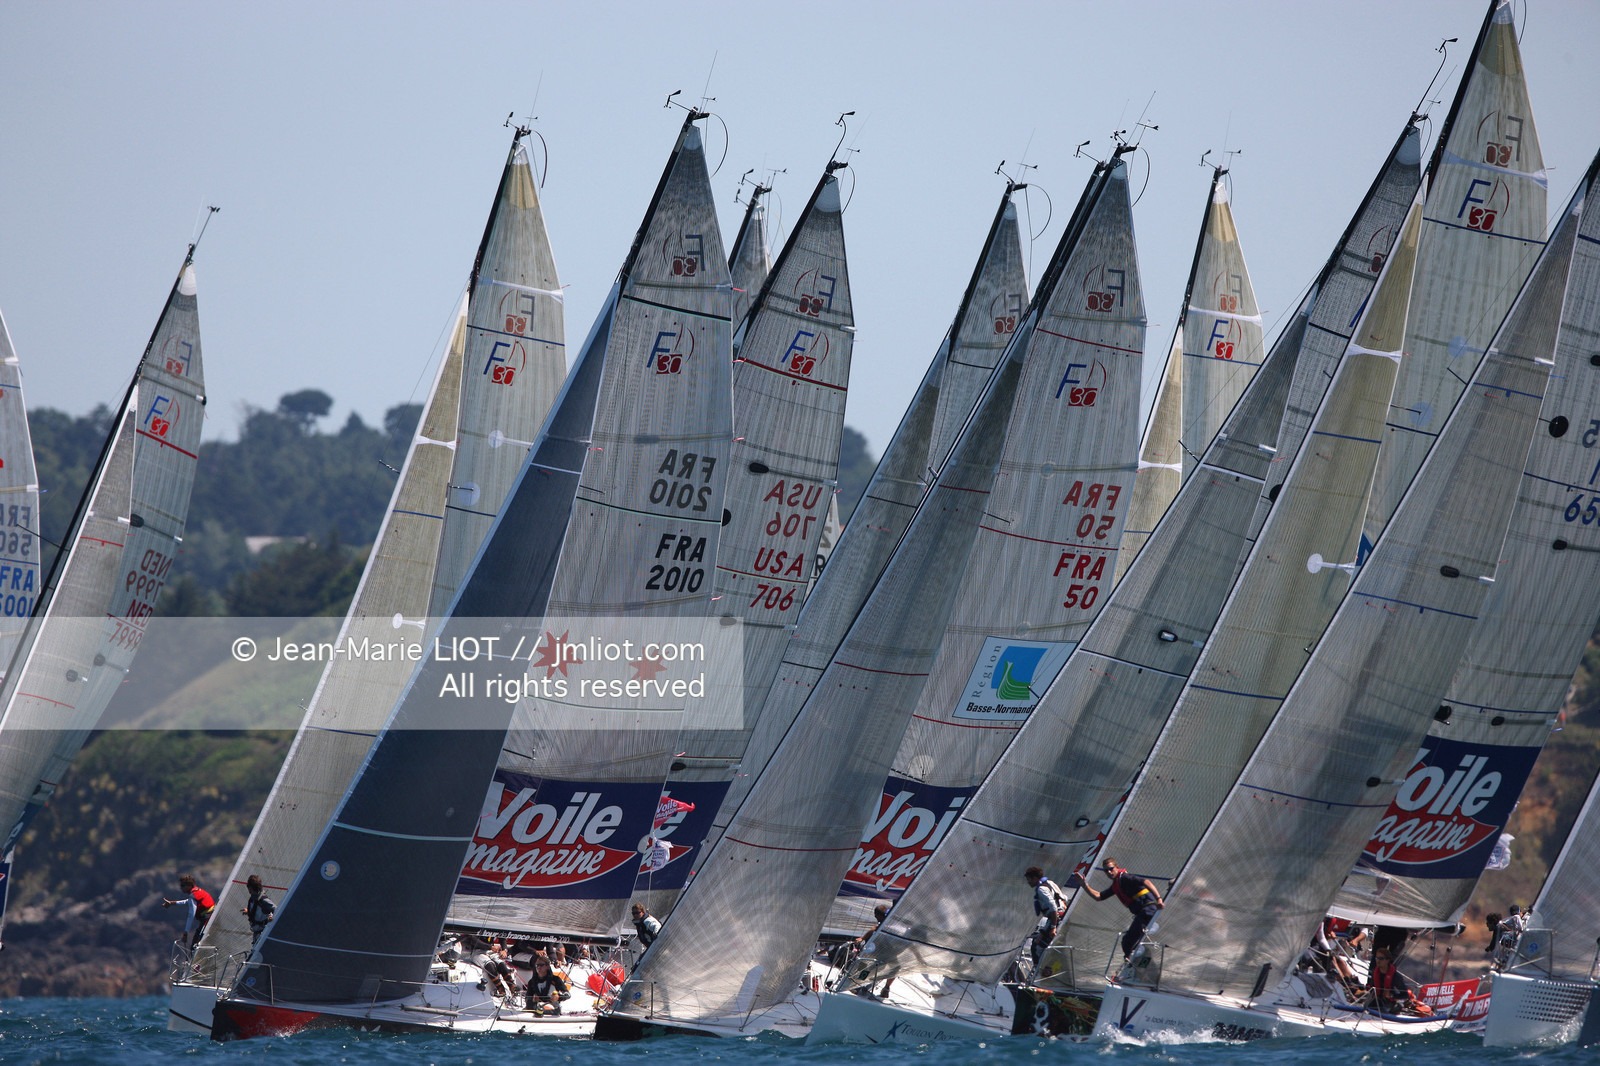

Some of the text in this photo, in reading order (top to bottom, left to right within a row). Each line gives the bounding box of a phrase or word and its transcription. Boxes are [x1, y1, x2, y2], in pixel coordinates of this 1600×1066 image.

[1457, 179, 1497, 232] F 30
[647, 331, 682, 374] F 30
[781, 330, 816, 376] F 30
[1207, 319, 1234, 360] F 30
[483, 341, 516, 386] F 30
[1055, 363, 1097, 407] F 30
[144, 395, 169, 424] F
[1564, 494, 1600, 527] 65
[655, 533, 707, 562] FRA
[754, 547, 804, 577] USA
[645, 564, 705, 593] 2010
[1053, 552, 1107, 580] FRA
[125, 599, 153, 628] NED
[750, 584, 797, 611] 706
[1063, 584, 1099, 610] 50
[108, 622, 143, 652] 7999
[966, 702, 1036, 714] Basse-Normandi
[477, 781, 623, 845] Voile
[861, 791, 970, 850] Voi
[1370, 815, 1475, 862] agazine
[463, 841, 606, 889] magazine
